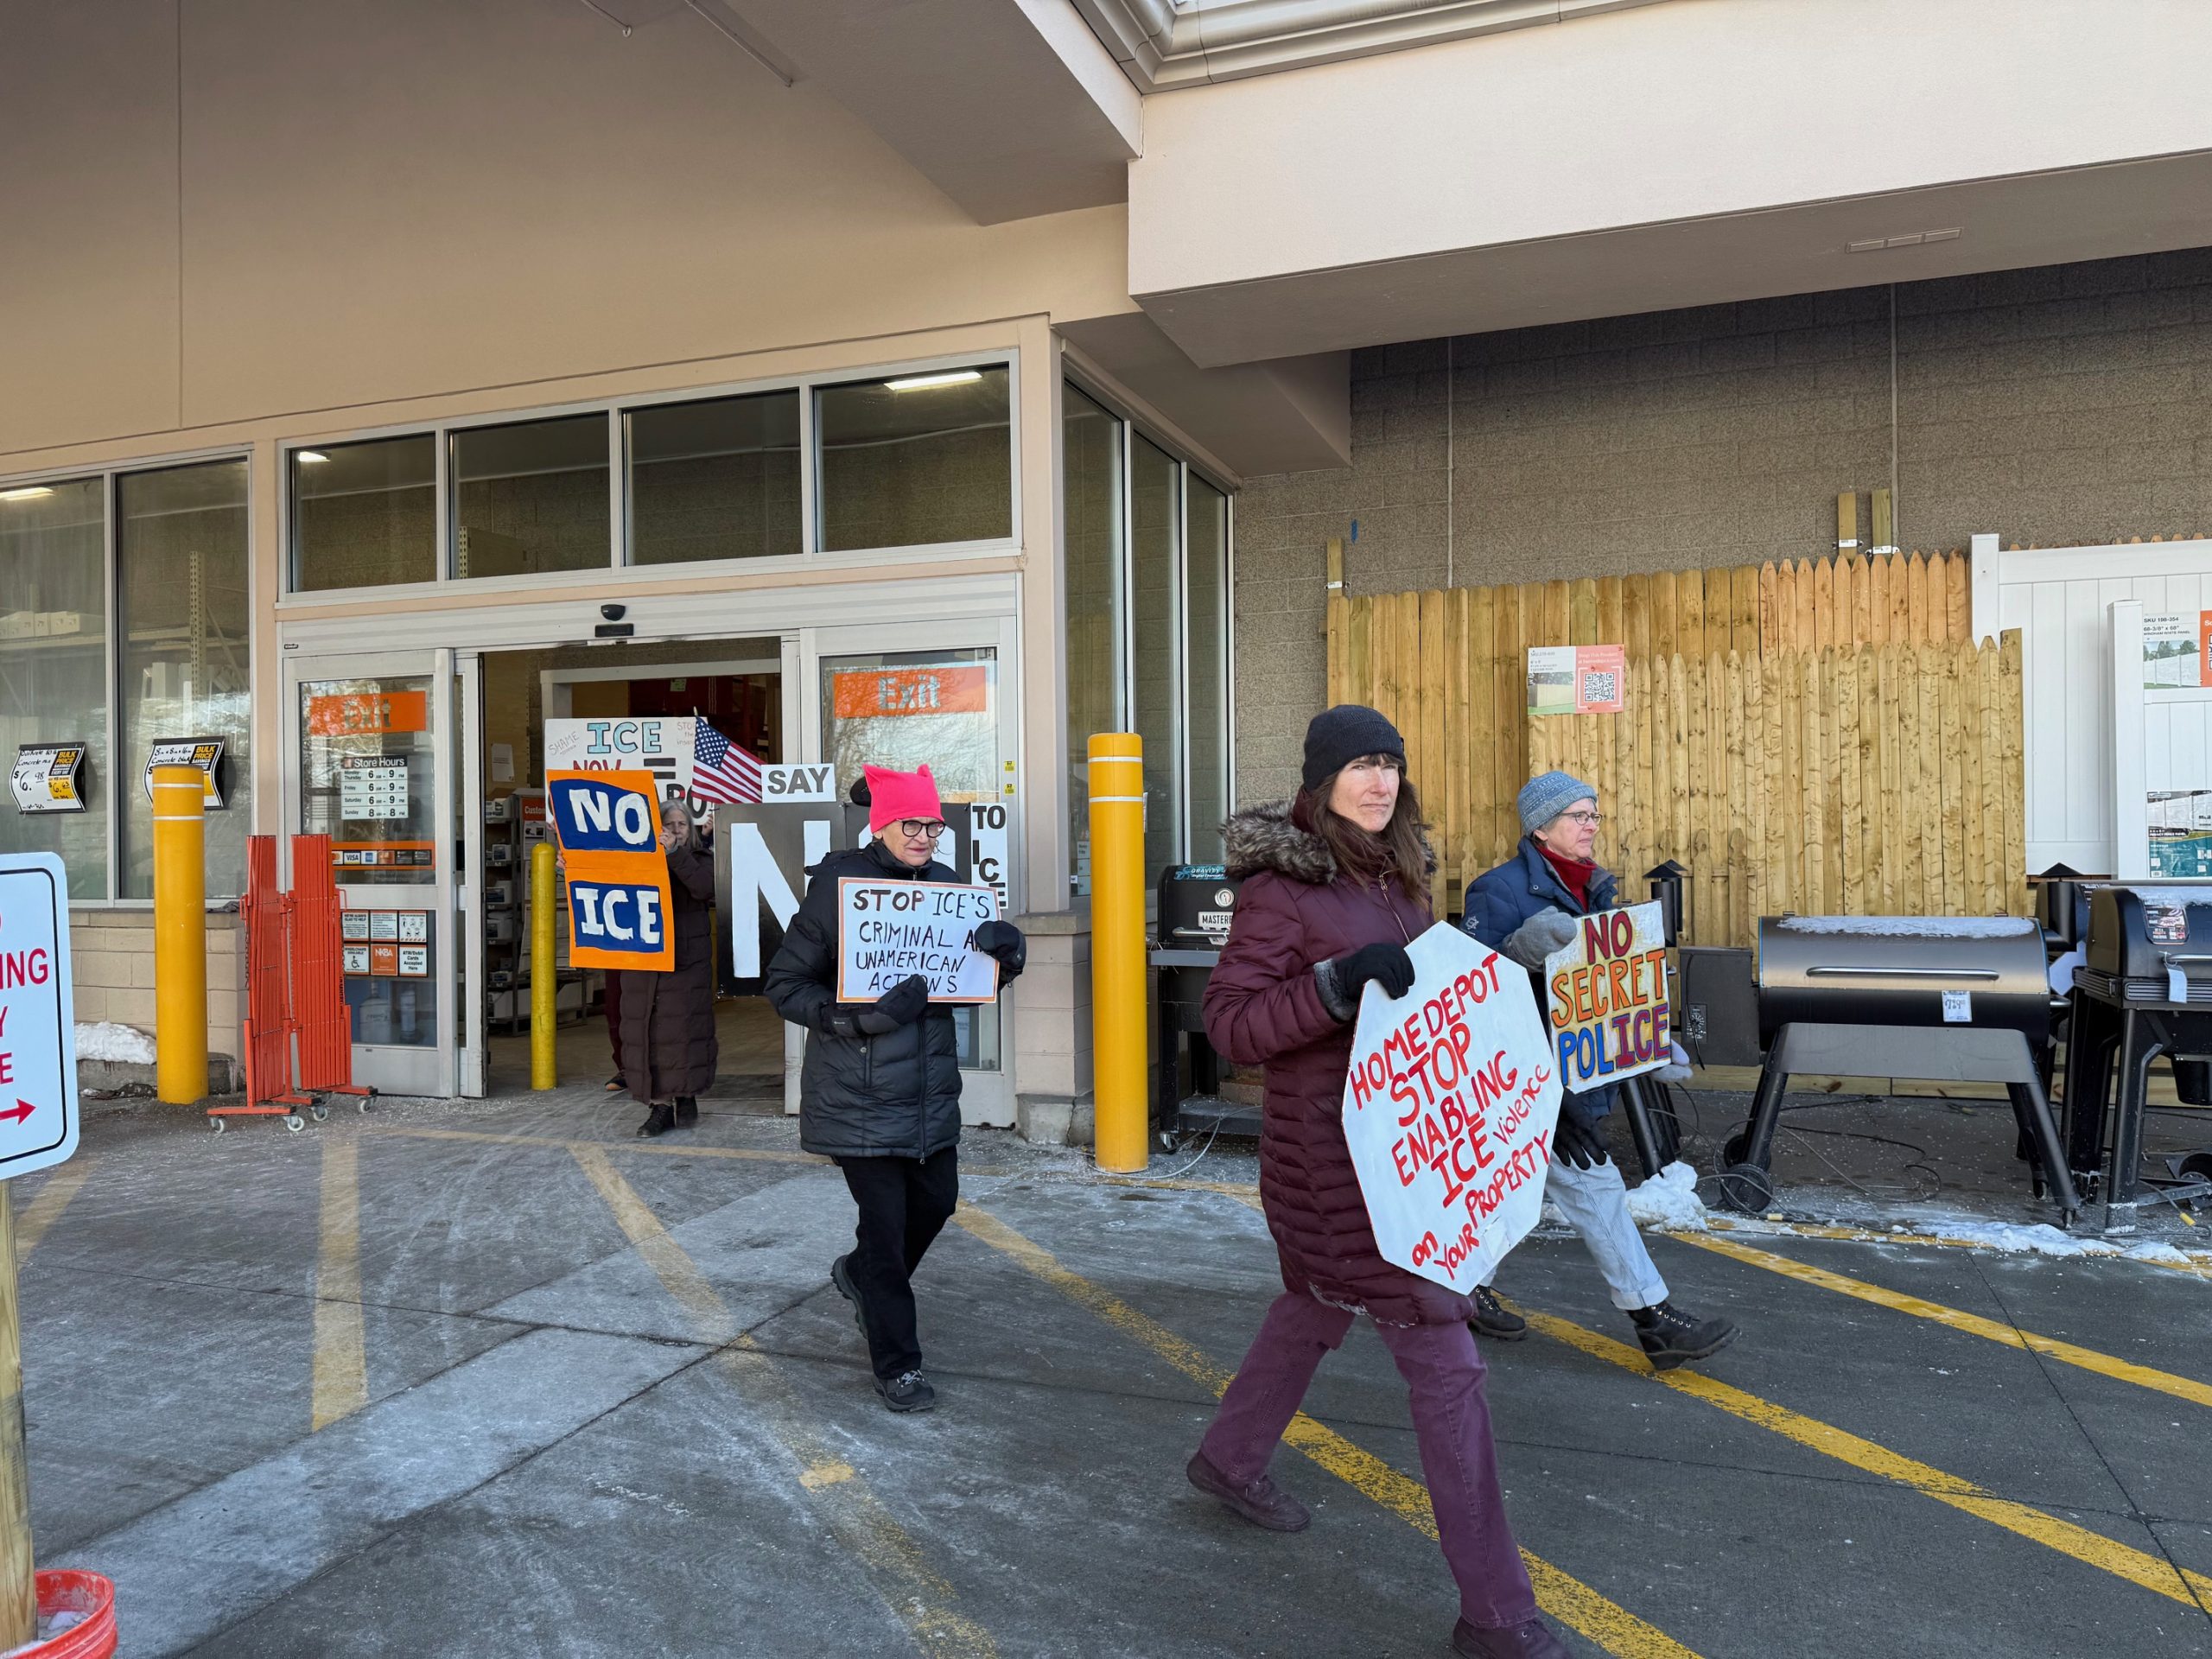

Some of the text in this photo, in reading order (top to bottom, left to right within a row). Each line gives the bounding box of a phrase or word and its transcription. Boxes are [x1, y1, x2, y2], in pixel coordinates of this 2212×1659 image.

[878, 672, 941, 709] Exit
[344, 698, 392, 731] Exit
[549, 731, 580, 756] SHAME
[587, 721, 662, 753] ICE
[354, 756, 405, 768] Store Hours
[368, 770, 374, 779] 6
[369, 783, 374, 791] 6
[389, 782, 395, 791] 9
[767, 766, 830, 794] SAY
[369, 796, 374, 804] 6
[389, 795, 395, 804] 9
[369, 809, 374, 817] 8
[390, 808, 396, 817] 8
[569, 788, 651, 845] NO
[972, 805, 1006, 830] TO
[575, 887, 660, 944] ICE
[853, 889, 990, 918] STOP ICE'S
[859, 921, 953, 949] CRIMINAL
[1584, 911, 1633, 965] NO
[375, 948, 394, 957] NKBA
[855, 950, 966, 973] UNAMERICAN
[868, 971, 957, 994] ACTNS
[1551, 948, 1666, 1027] SECRET
[1351, 951, 1500, 1111] HOME DEPOT
[1558, 1002, 1670, 1086] POLICE
[1389, 1022, 1471, 1128] STOP
[1391, 1050, 1518, 1187] ENABLING
[1431, 1117, 1495, 1208] ICE
[1433, 1128, 1550, 1281] YOUR PROPERTY
[1412, 1230, 1439, 1268] on
